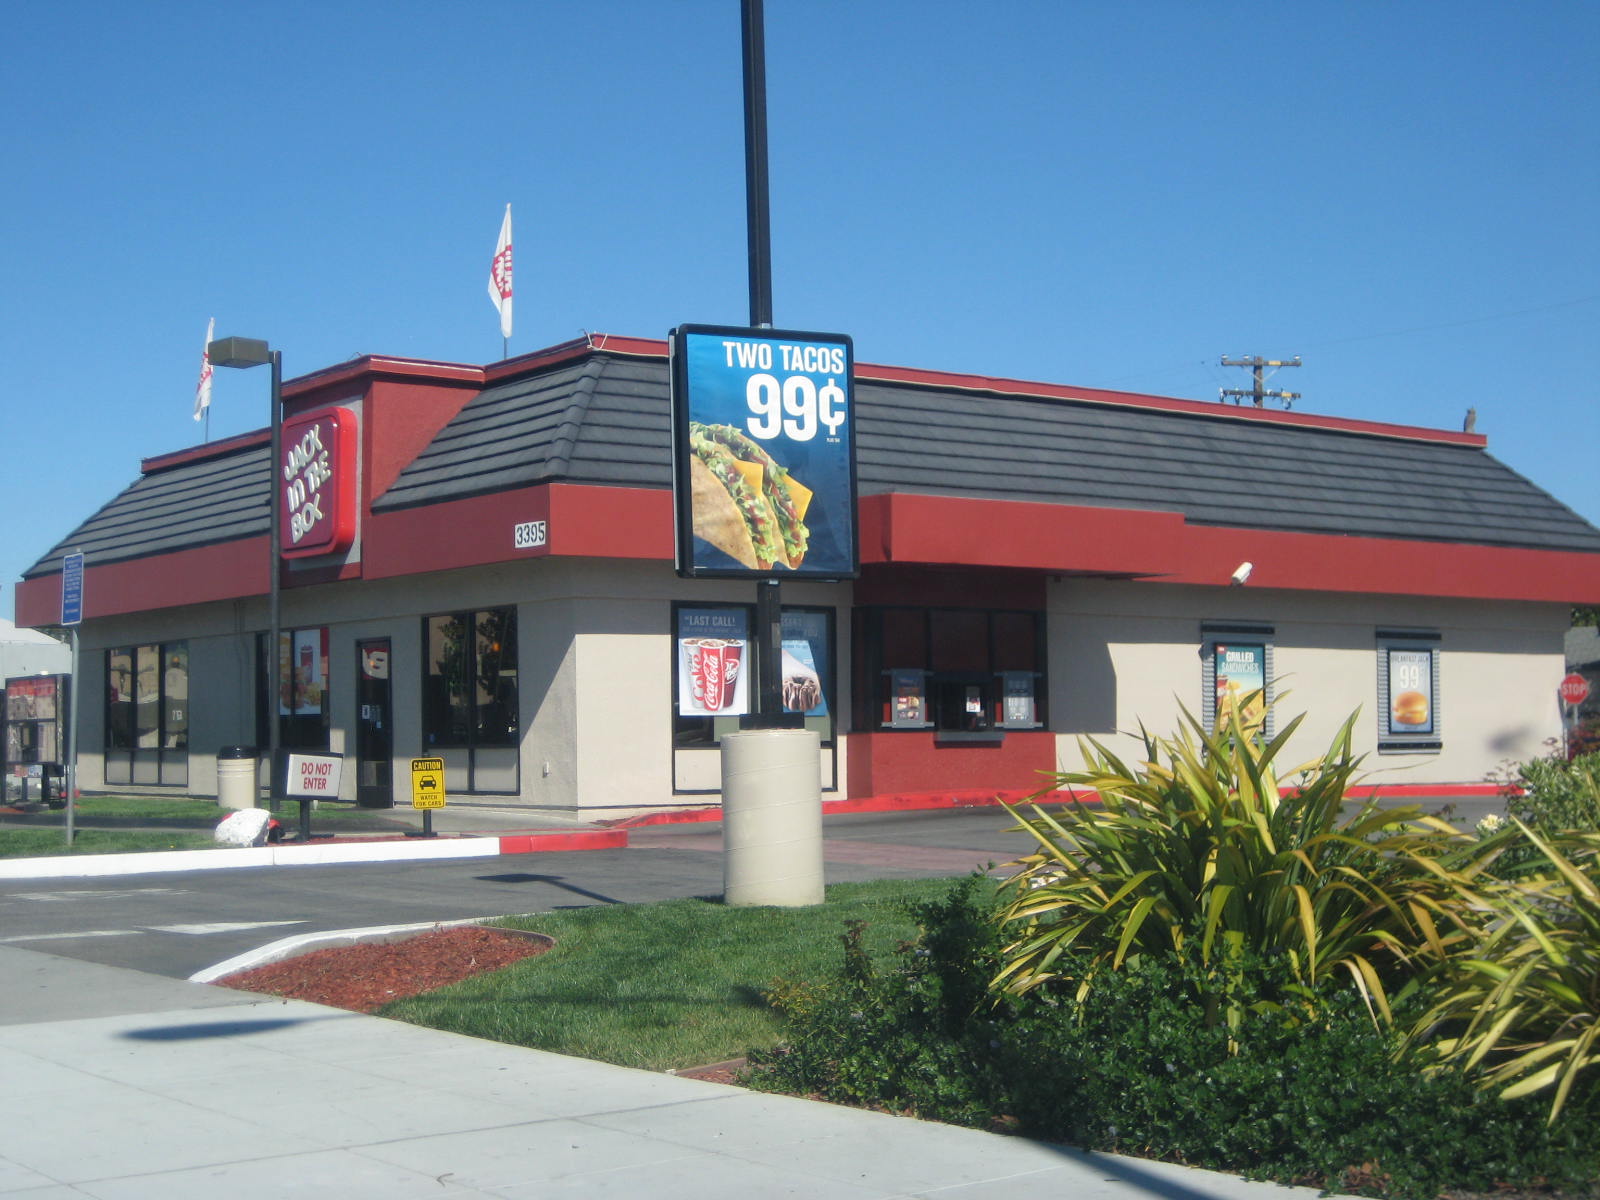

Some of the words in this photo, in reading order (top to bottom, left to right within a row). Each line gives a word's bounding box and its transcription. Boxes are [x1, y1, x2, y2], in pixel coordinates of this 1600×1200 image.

[723, 341, 772, 370] TWO
[779, 344, 844, 374] TACOS
[746, 373, 846, 442] 99¢
[284, 424, 322, 481] JACK
[290, 493, 323, 545] BOX
[516, 522, 545, 546] 3395
[1225, 651, 1254, 663] GRILLED
[1561, 683, 1586, 697] STOP
[300, 762, 314, 775] DO
[315, 763, 332, 776] NOT
[413, 761, 441, 771] CAUTION
[303, 777, 327, 790] ENTER
